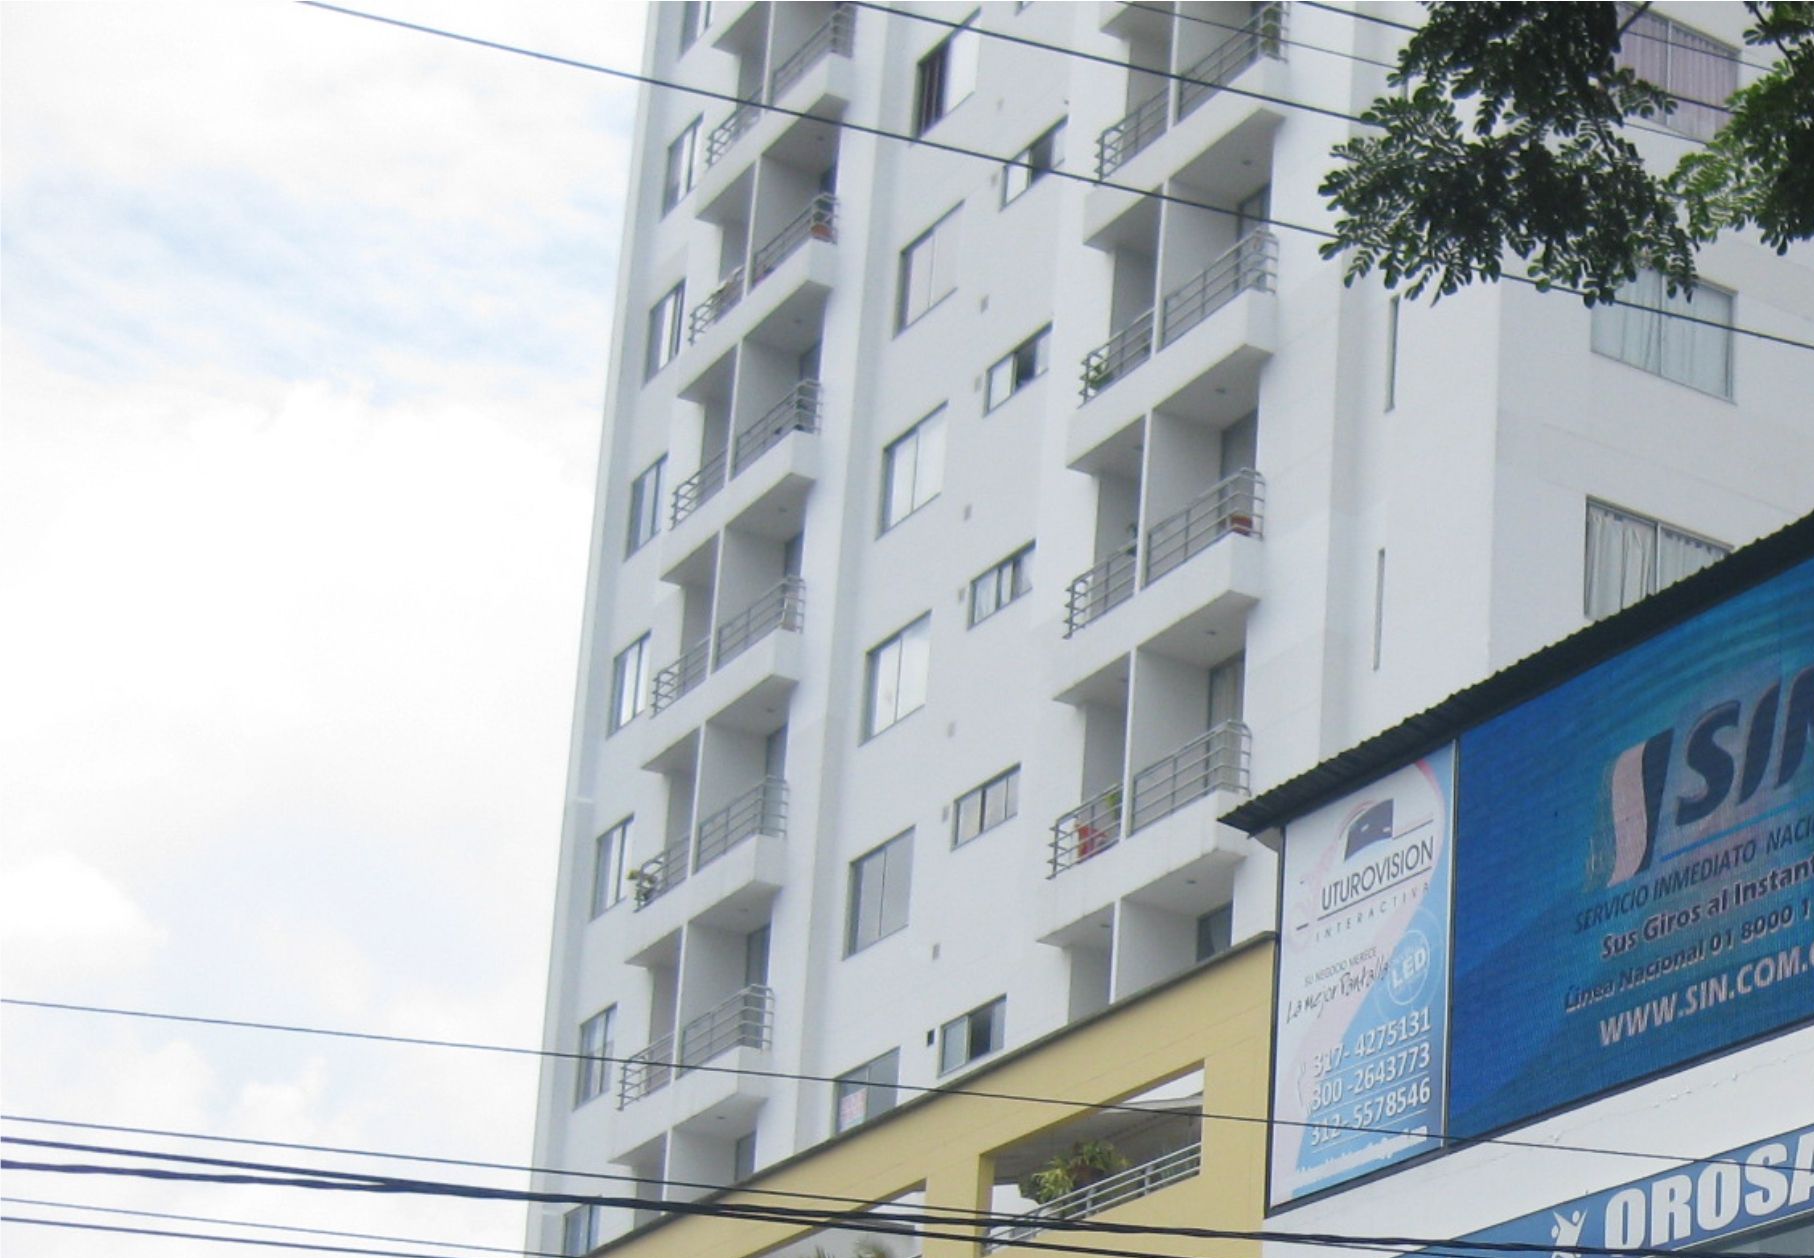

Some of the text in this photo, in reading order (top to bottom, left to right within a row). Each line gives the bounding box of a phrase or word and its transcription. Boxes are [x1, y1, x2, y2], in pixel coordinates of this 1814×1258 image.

[1316, 883, 1429, 941] INTERACTIVA
[1574, 885, 1648, 934] SERVICIO
[1653, 839, 1757, 900] INMEDIATO
[1602, 931, 1636, 959] Sus
[1643, 904, 1701, 943] Giros
[1707, 889, 1728, 914] al
[1620, 940, 1706, 992] Nacional
[1710, 928, 1734, 956] 01
[1741, 904, 1794, 943] 8000
[1391, 948, 1428, 988] LED
